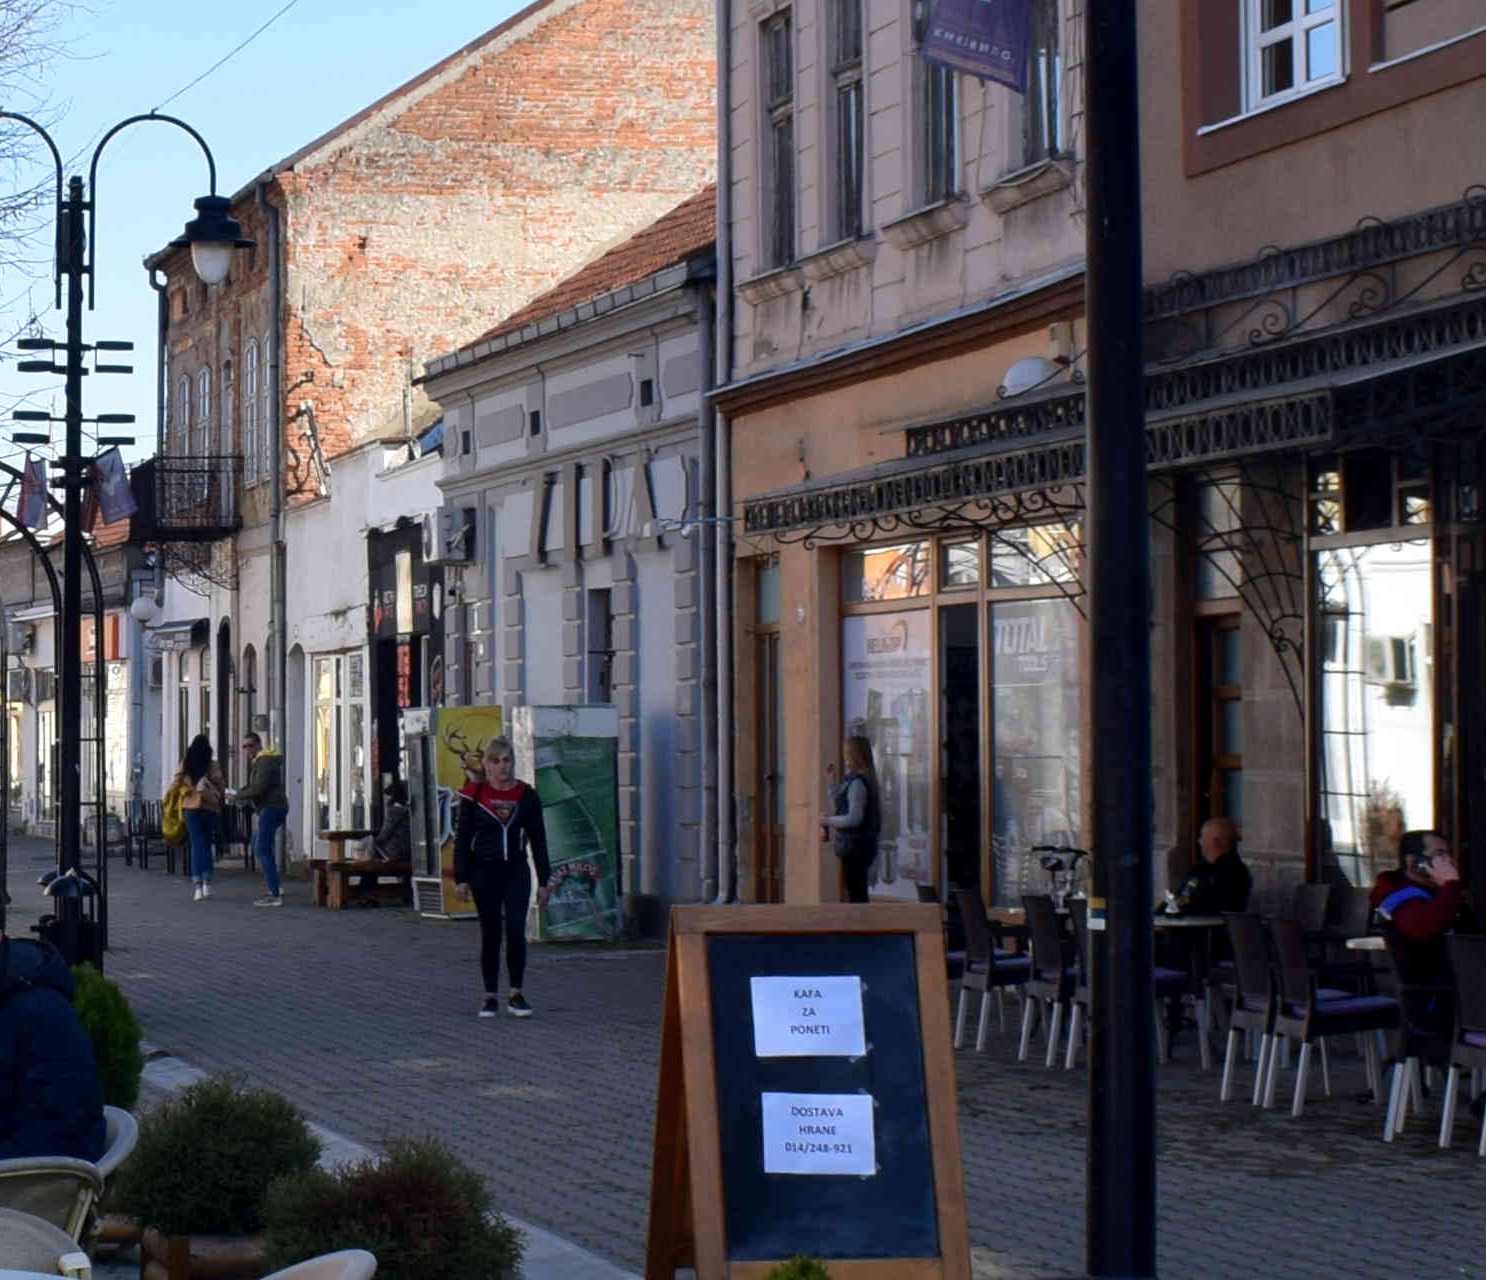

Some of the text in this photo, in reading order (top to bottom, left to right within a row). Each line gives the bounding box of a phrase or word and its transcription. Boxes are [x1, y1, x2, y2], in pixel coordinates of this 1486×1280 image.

[793, 988, 823, 1000] KAFA
[801, 1006, 817, 1017] ZA
[790, 1024, 831, 1036] PONETI
[791, 1105, 845, 1118] DOSTAVA
[798, 1124, 837, 1136] HRANE
